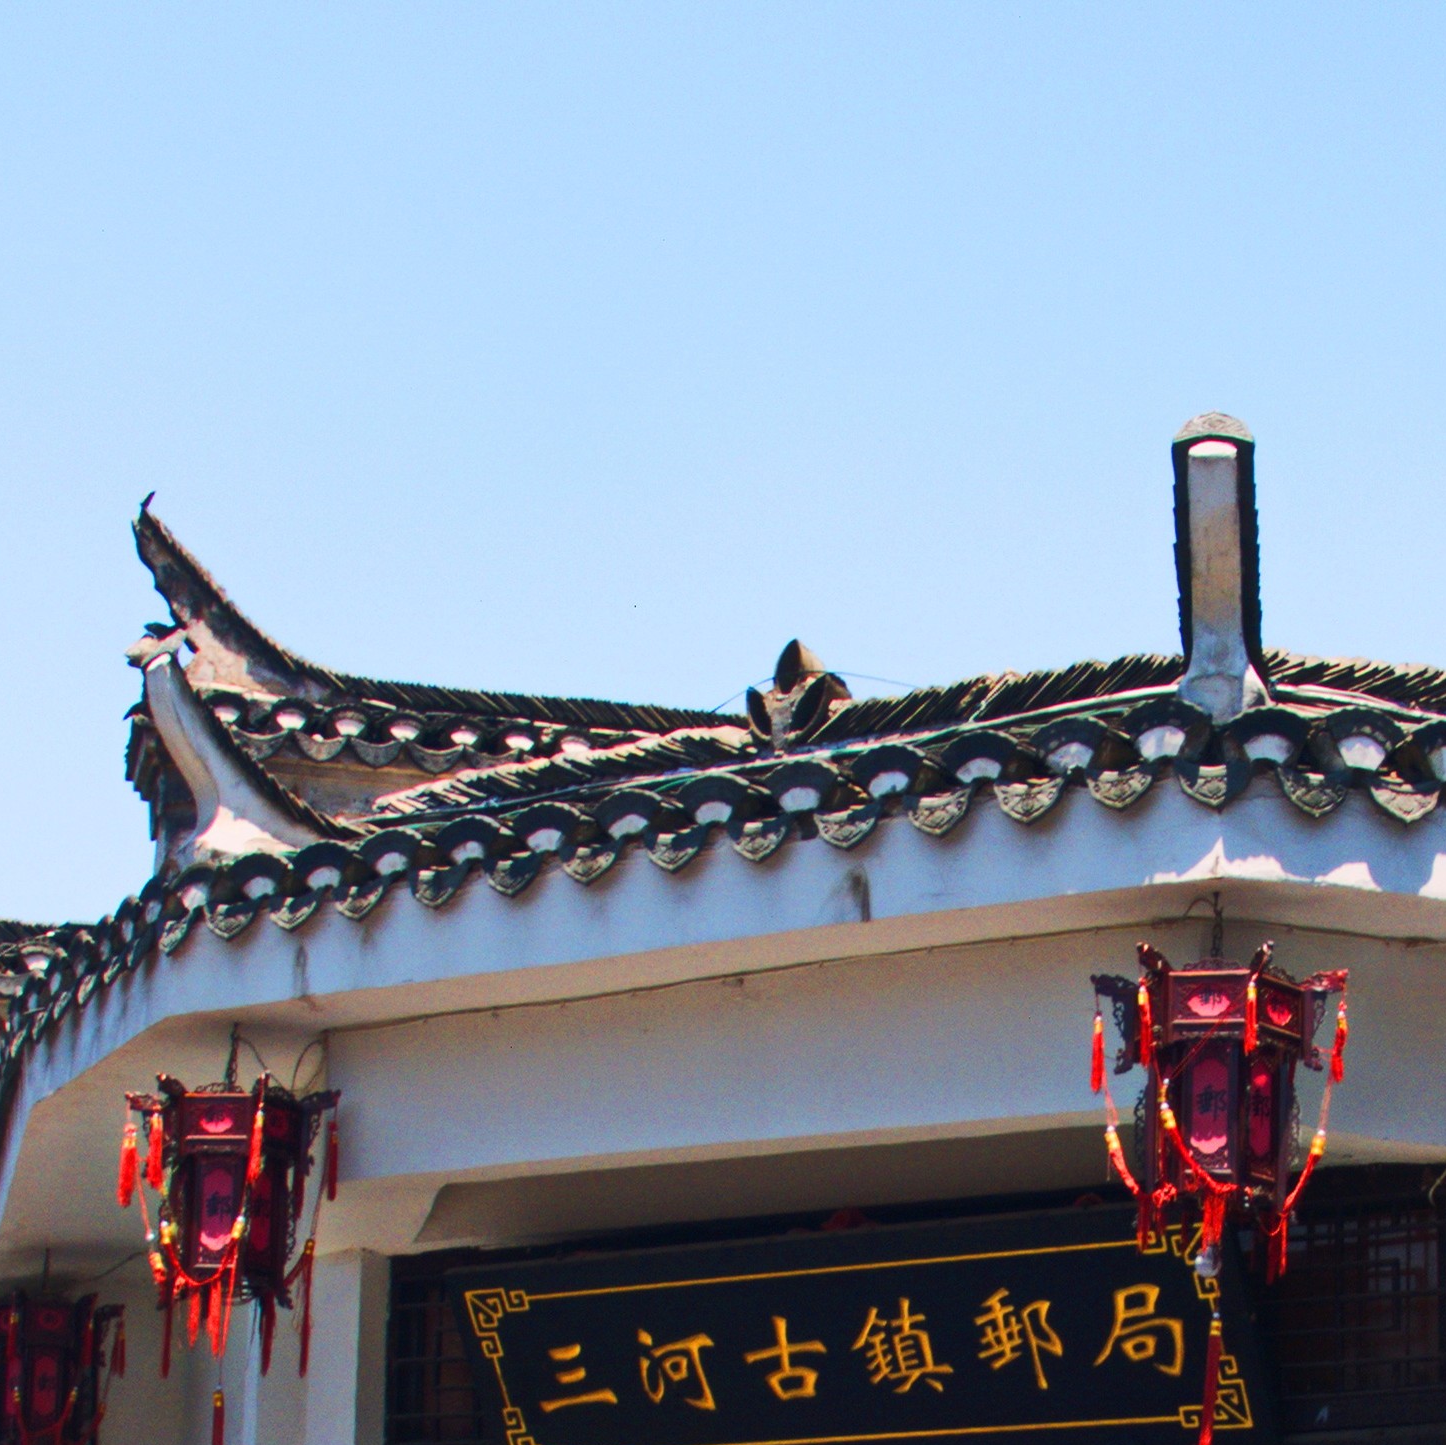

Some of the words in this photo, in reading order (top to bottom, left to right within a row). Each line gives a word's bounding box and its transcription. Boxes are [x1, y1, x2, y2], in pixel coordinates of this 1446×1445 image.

[540, 1283, 1184, 1413] 三河古鎮郵局
